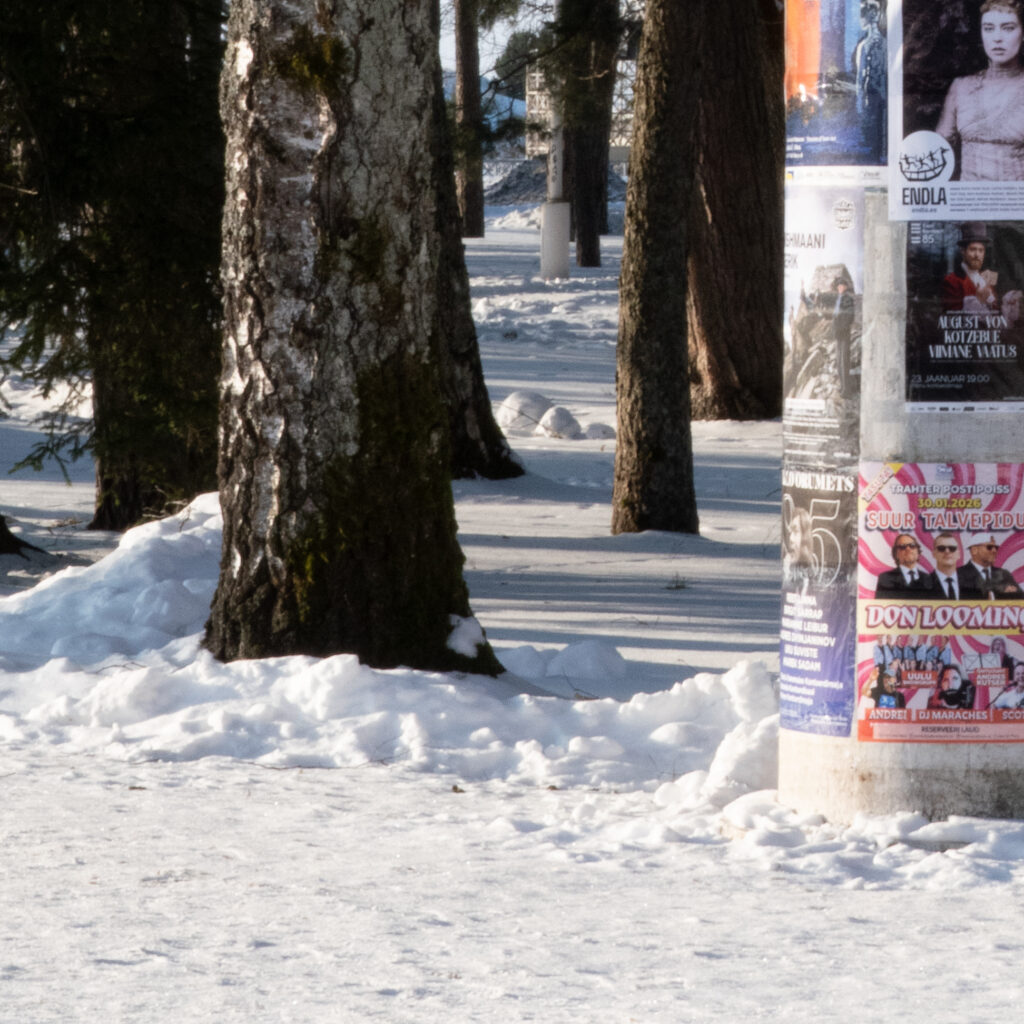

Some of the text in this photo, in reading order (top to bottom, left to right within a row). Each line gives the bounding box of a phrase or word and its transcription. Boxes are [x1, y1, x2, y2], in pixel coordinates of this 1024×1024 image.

[902, 187, 947, 205] ENDLA
[938, 315, 1008, 329] AUGUST VON
[944, 330, 1001, 344] KOTZEBUE
[929, 344, 1017, 358] VIIMANE VAATUS
[890, 484, 1011, 495] TRAHTER POSTIPOISS
[917, 498, 982, 509] 30.01.2026
[867, 511, 916, 529] SUUR
[866, 605, 917, 629] DON
[869, 710, 907, 720] ANDREI
[919, 710, 988, 720] DJ MARACHES
